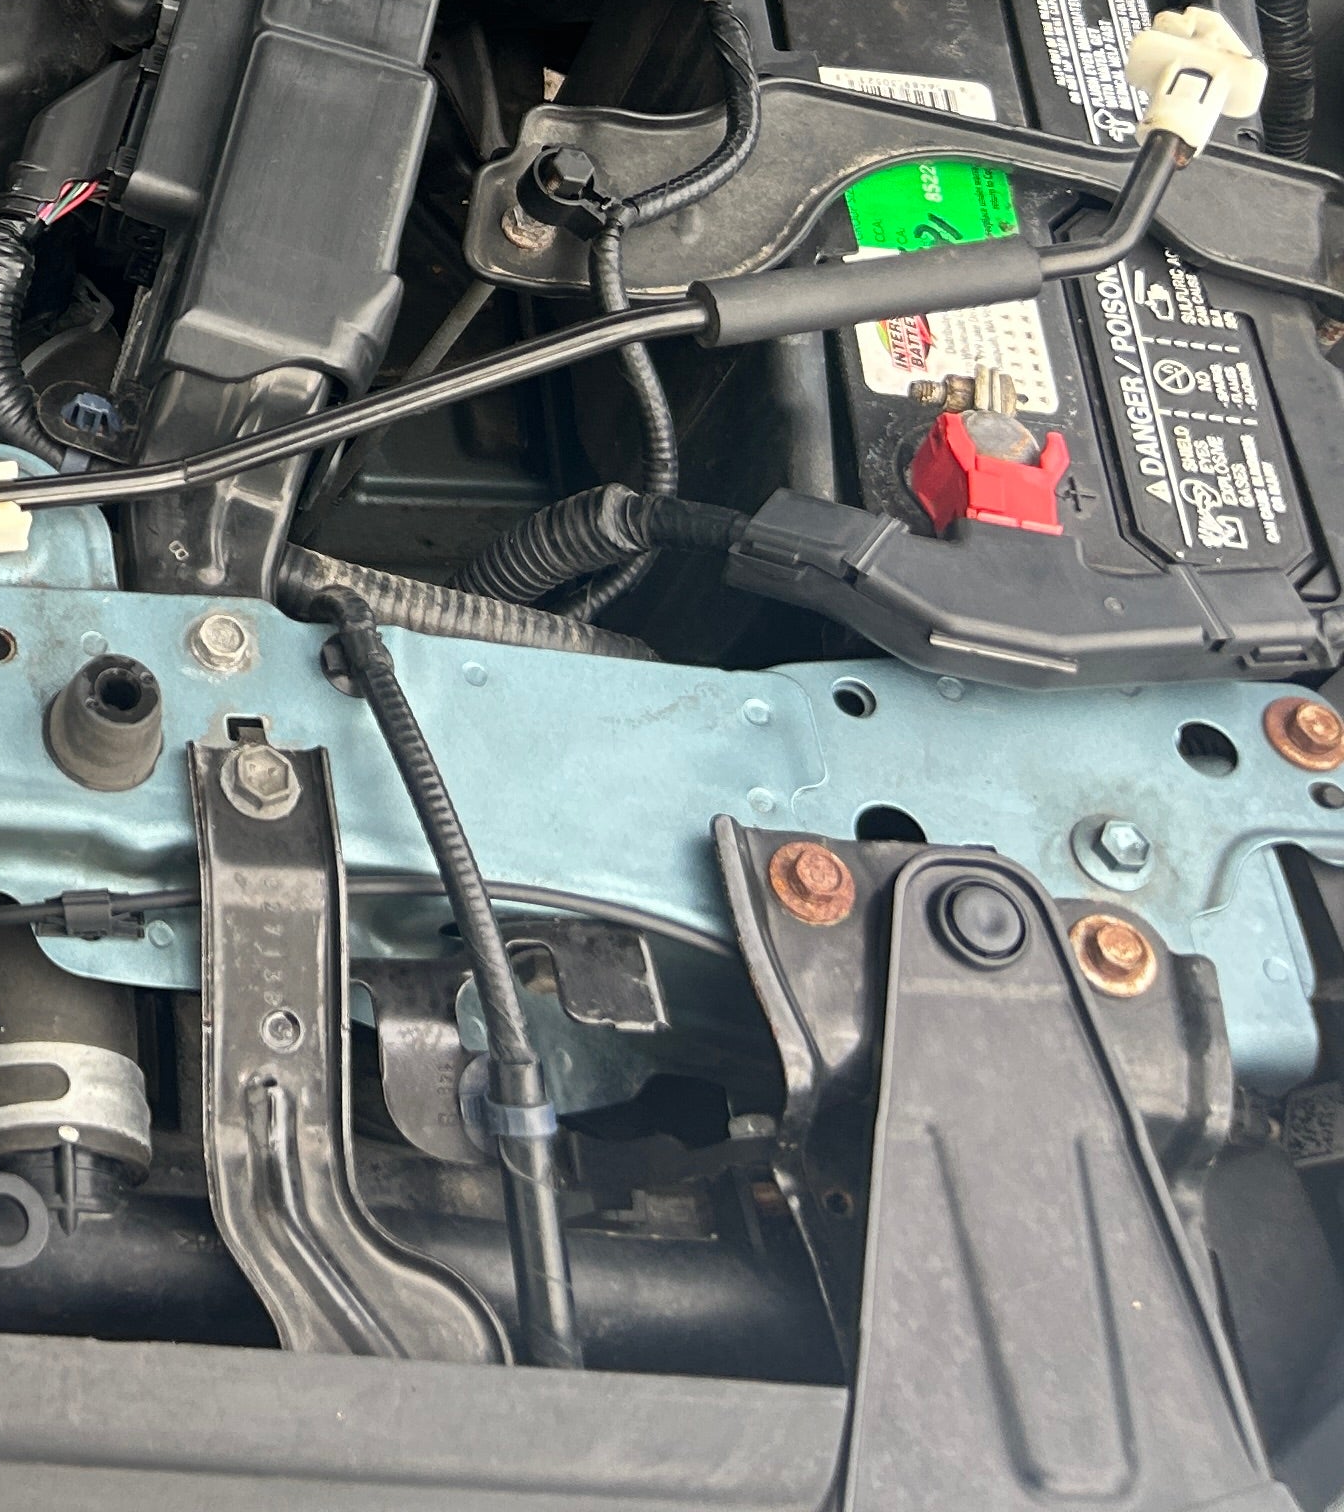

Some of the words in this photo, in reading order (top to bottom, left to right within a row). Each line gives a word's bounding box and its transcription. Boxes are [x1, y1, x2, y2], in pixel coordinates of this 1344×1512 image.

[1098, 20, 1115, 42] FAST
[1079, 52, 1097, 75] EYES
[1103, 44, 1121, 67] HELP
[916, 165, 944, 201] 8522
[1168, 268, 1197, 324] SULFURIC
[1194, 371, 1213, 390] NO
[1119, 376, 1166, 476] DANGER
[1172, 426, 1199, 470] SHIELD
[1192, 440, 1215, 472] EYES
[1206, 435, 1238, 505] EXPLOSIVE
[1229, 463, 1255, 506] GASES
